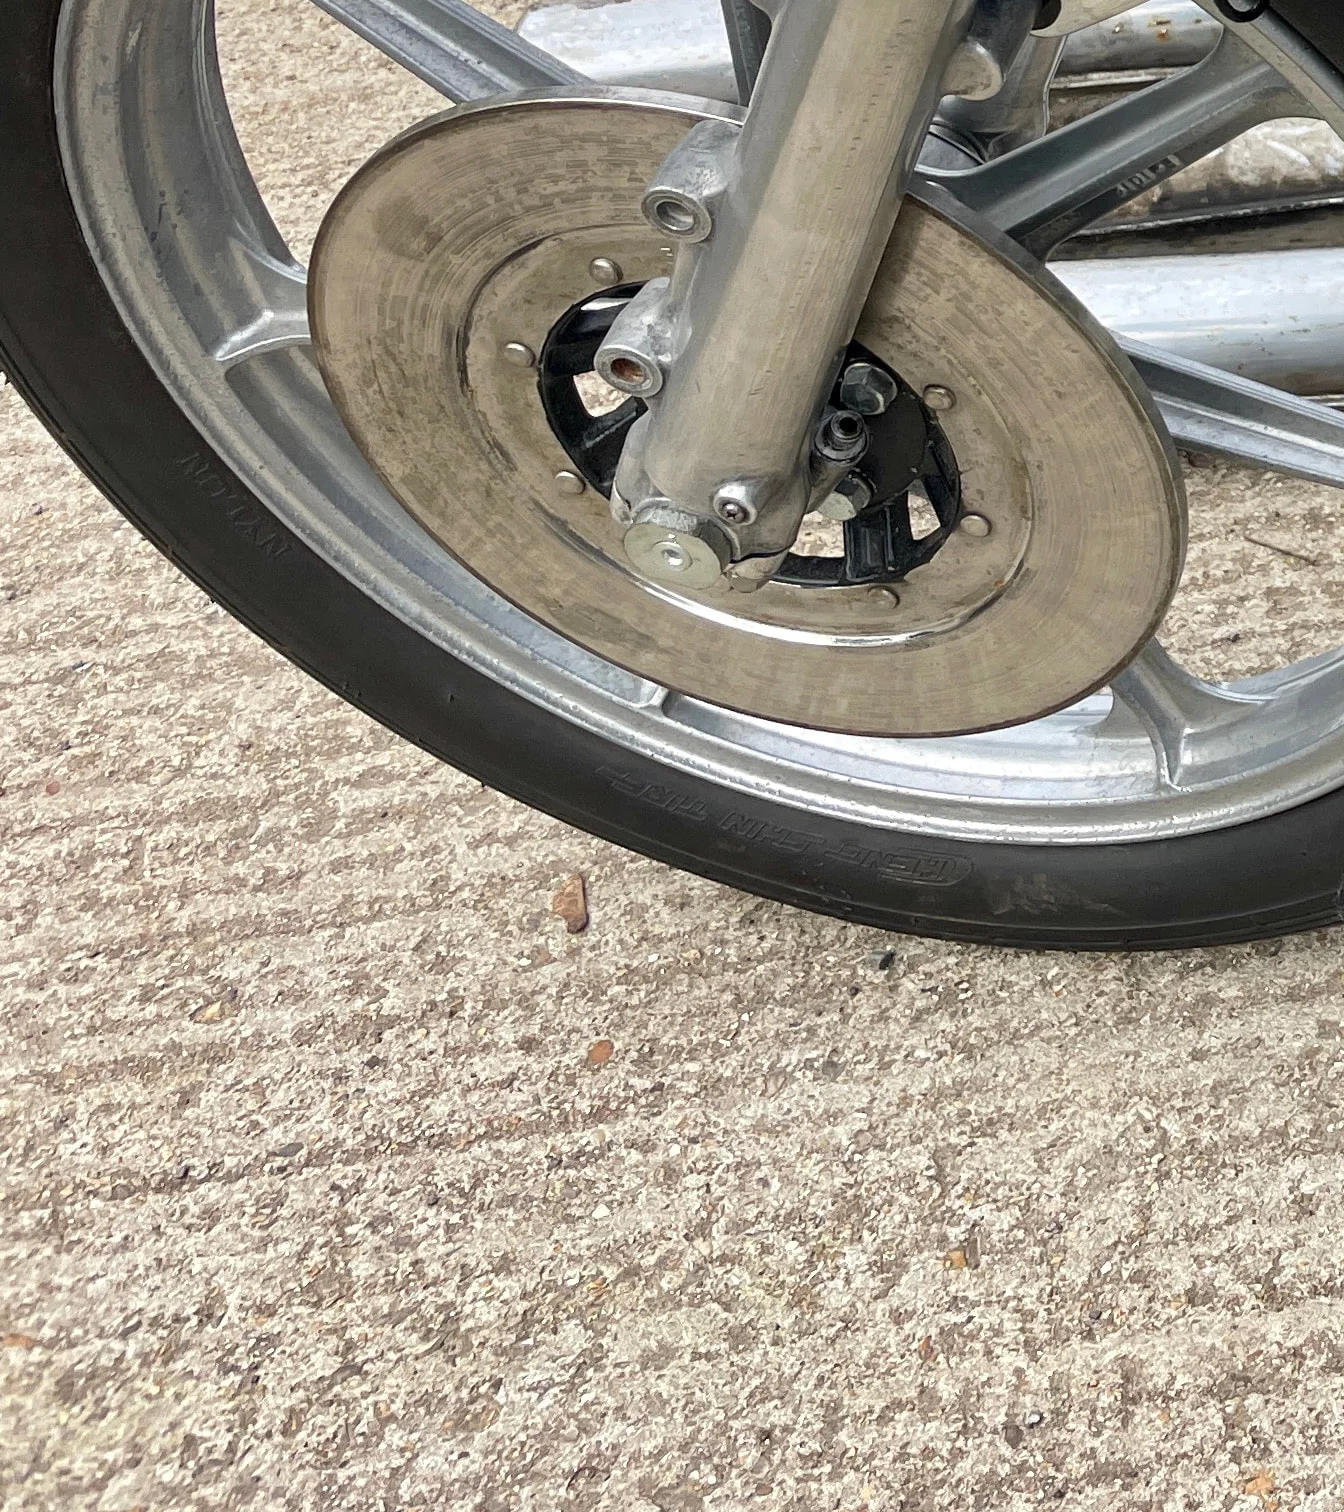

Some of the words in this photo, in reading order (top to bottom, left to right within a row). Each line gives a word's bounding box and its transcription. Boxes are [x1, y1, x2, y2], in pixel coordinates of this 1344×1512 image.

[175, 450, 294, 559] NYLON
[595, 764, 714, 823] TIRE
[719, 810, 828, 855] SHIN
[823, 835, 975, 888] CHENG
